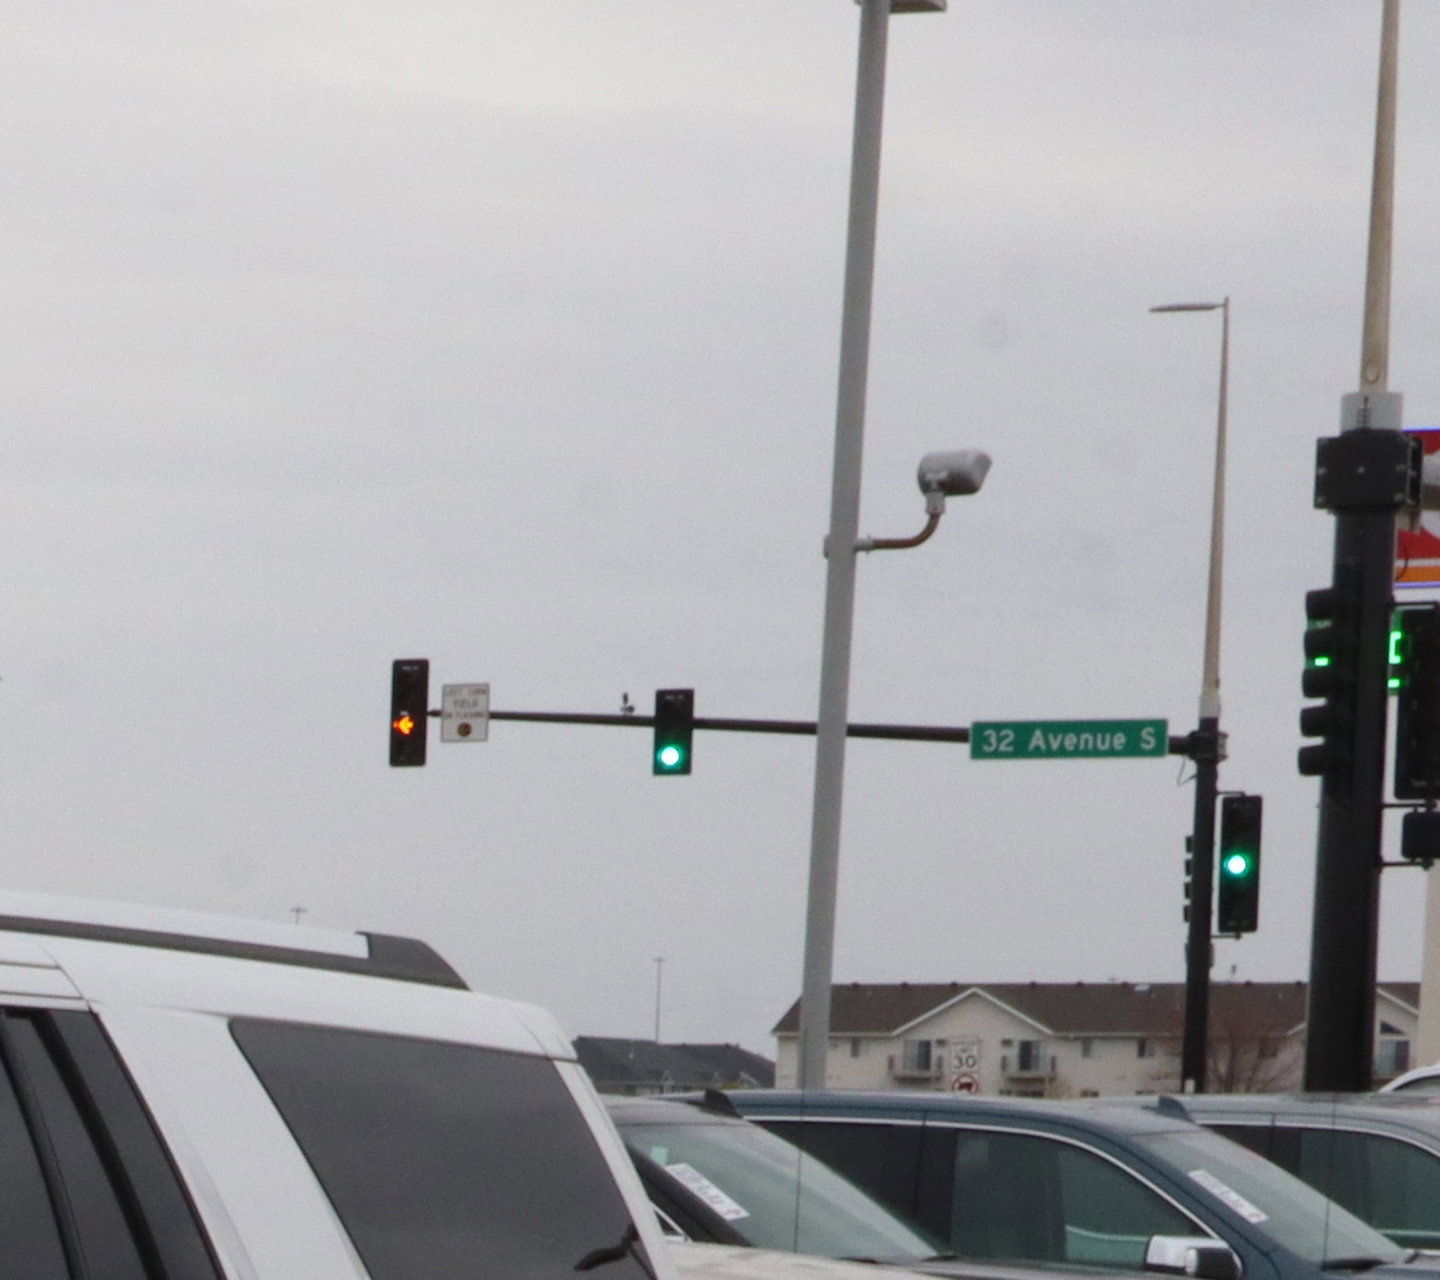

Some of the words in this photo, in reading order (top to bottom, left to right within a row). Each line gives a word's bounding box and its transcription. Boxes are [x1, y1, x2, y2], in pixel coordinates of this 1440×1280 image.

[983, 729, 1015, 752] 32
[1029, 730, 1127, 750] Avenue
[1140, 727, 1156, 750] S
[953, 1055, 977, 1069] 30
